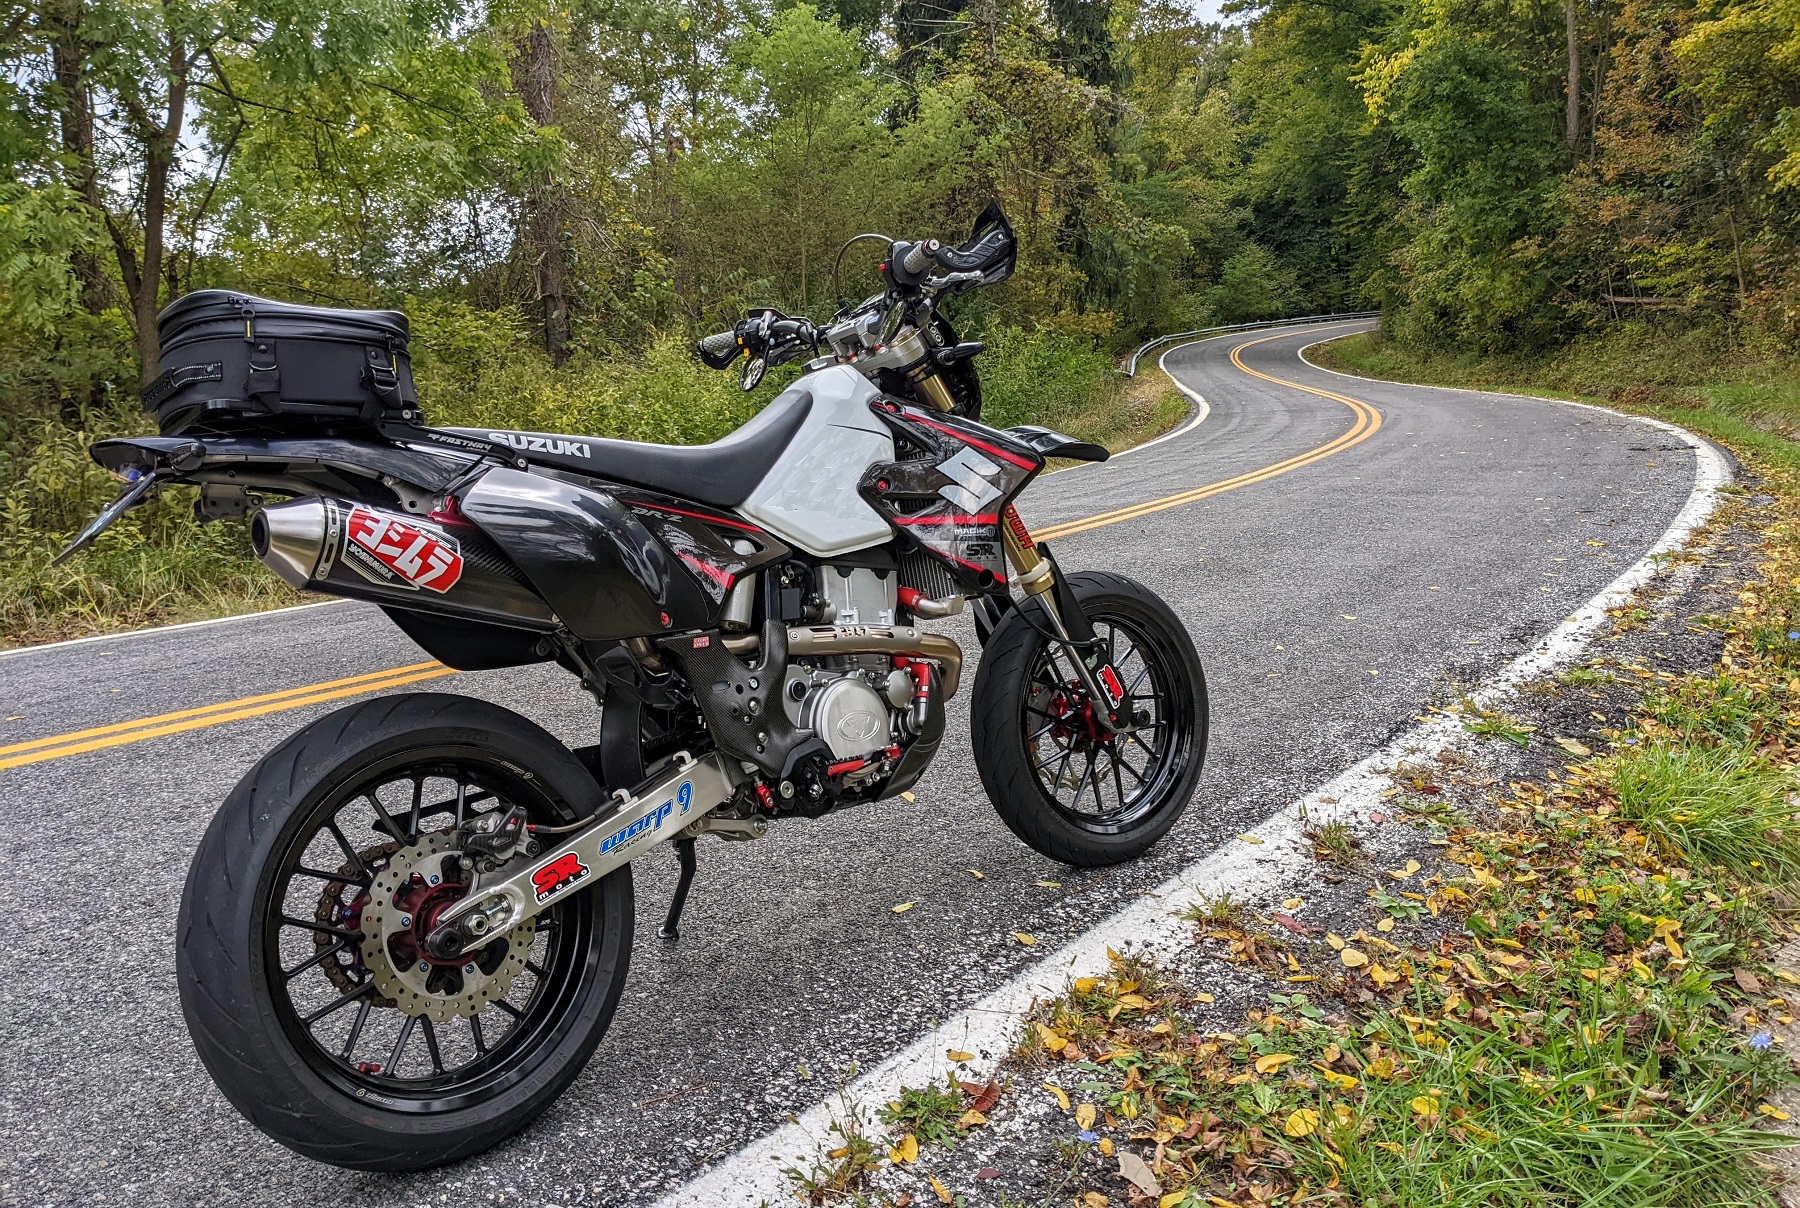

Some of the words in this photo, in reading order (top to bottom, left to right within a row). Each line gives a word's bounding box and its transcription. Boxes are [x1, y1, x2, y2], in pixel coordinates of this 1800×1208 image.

[488, 432, 591, 459] SUZUKI
[1004, 503, 1035, 549] OWA
[348, 543, 395, 580] YOSHIMURA
[356, 512, 455, 586] ヨシムラ
[600, 799, 673, 856] warp
[677, 780, 693, 816] 9
[612, 829, 653, 856] Racing
[532, 852, 586, 895] SR
[538, 869, 588, 900] moto
